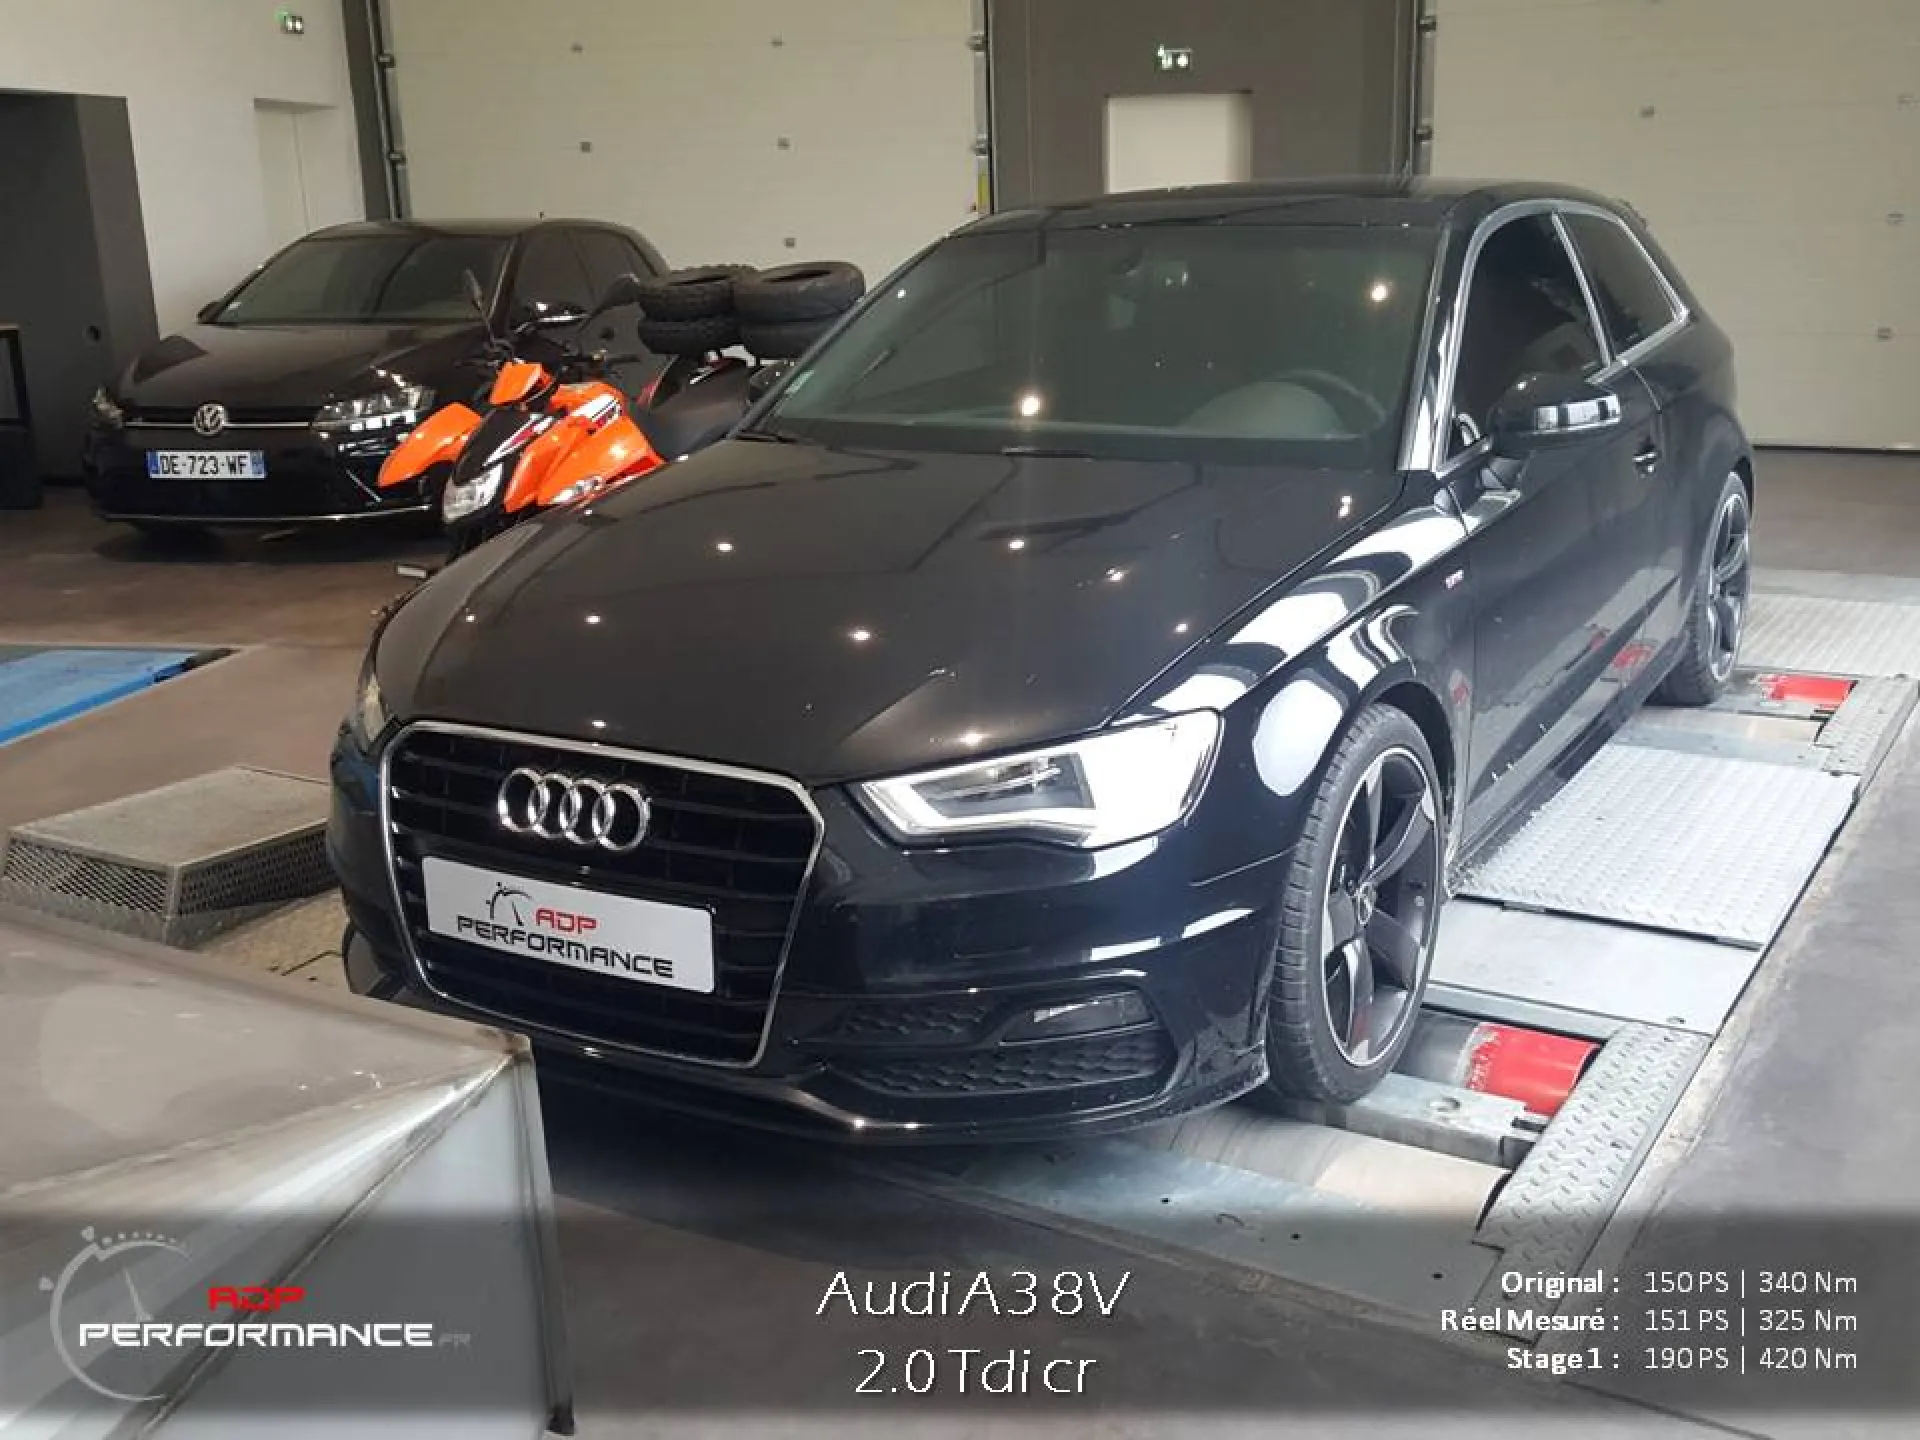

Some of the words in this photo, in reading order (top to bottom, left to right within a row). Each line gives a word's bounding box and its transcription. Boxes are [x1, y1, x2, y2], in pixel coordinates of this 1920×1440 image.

[160, 455, 248, 474] DE-723-WF
[535, 908, 597, 934] ADP
[457, 915, 674, 978] PERFORMANCE
